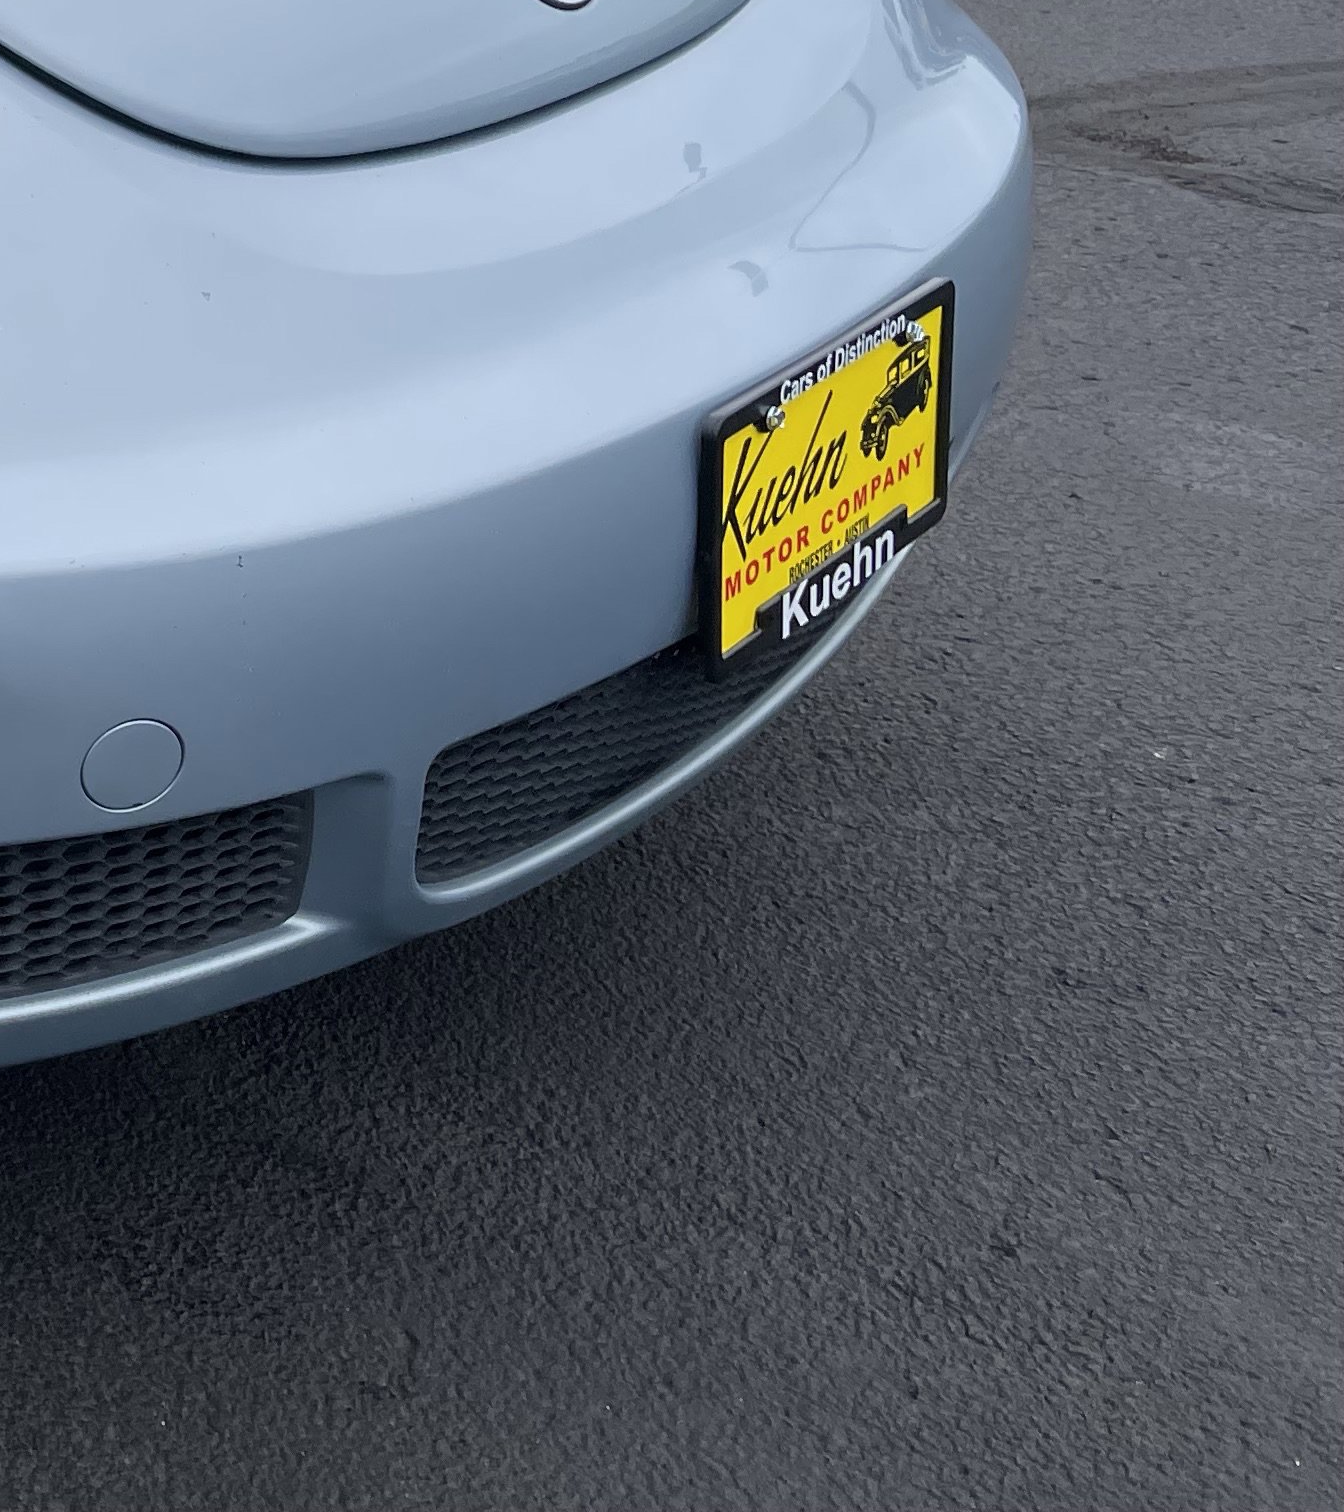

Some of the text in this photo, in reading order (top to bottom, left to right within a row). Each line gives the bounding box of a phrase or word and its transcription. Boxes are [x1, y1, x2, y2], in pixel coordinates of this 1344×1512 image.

[780, 314, 906, 405] Cars of Distinction
[723, 390, 848, 562] Kuehn
[725, 443, 926, 601] MOTOR COMPANY
[781, 529, 895, 640] Kuehn
[789, 512, 870, 585] ROCHESTER AUSTIN
